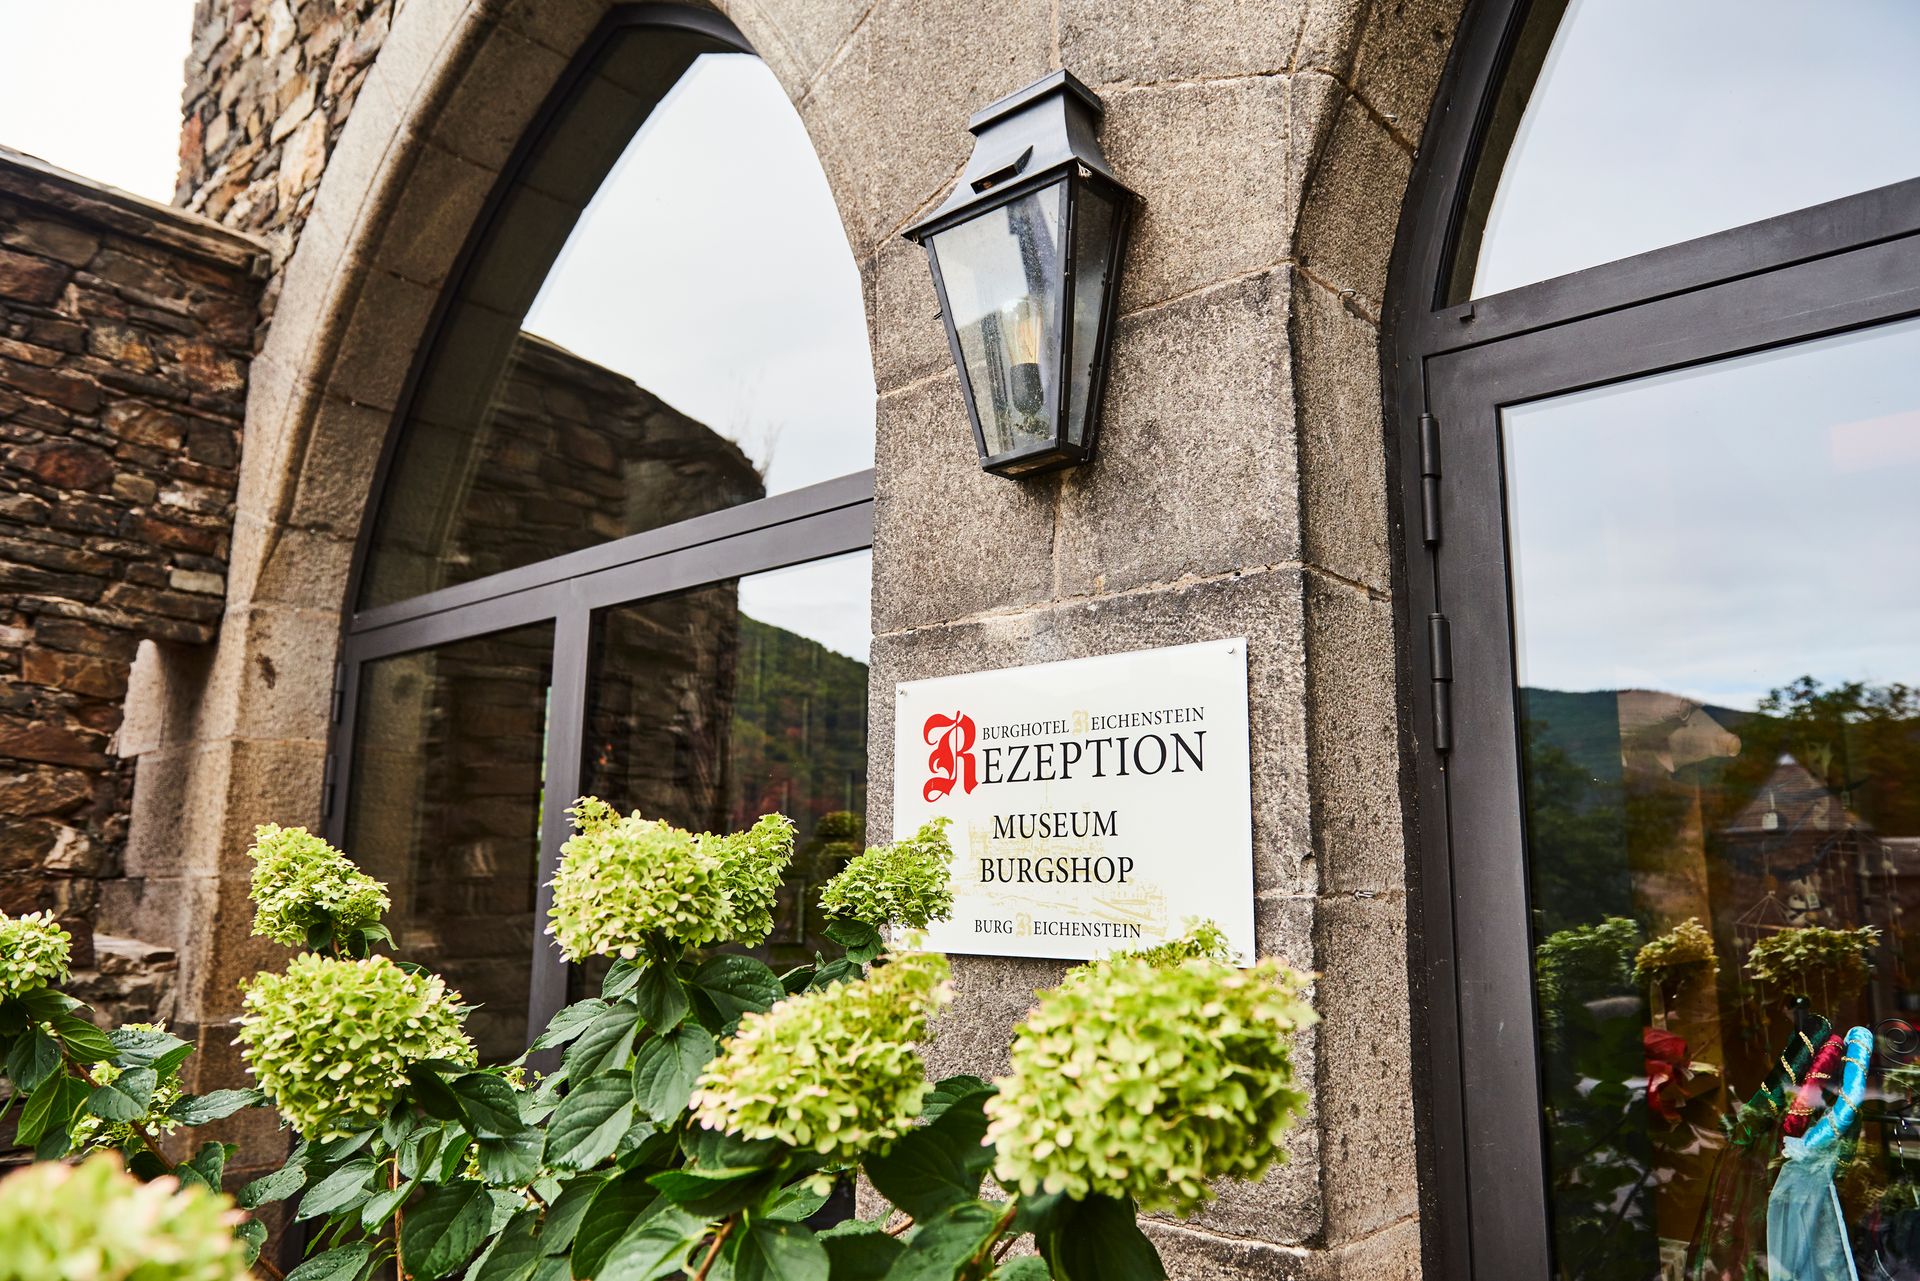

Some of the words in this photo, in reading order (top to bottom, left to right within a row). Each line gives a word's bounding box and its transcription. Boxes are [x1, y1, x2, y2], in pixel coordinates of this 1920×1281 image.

[982, 719, 1070, 740] BURGHOTEL
[922, 710, 1207, 803] REZEPTION
[992, 810, 1119, 840] MUSEUM
[980, 856, 1134, 884] BURGSHOP
[974, 919, 1013, 935] BURG
